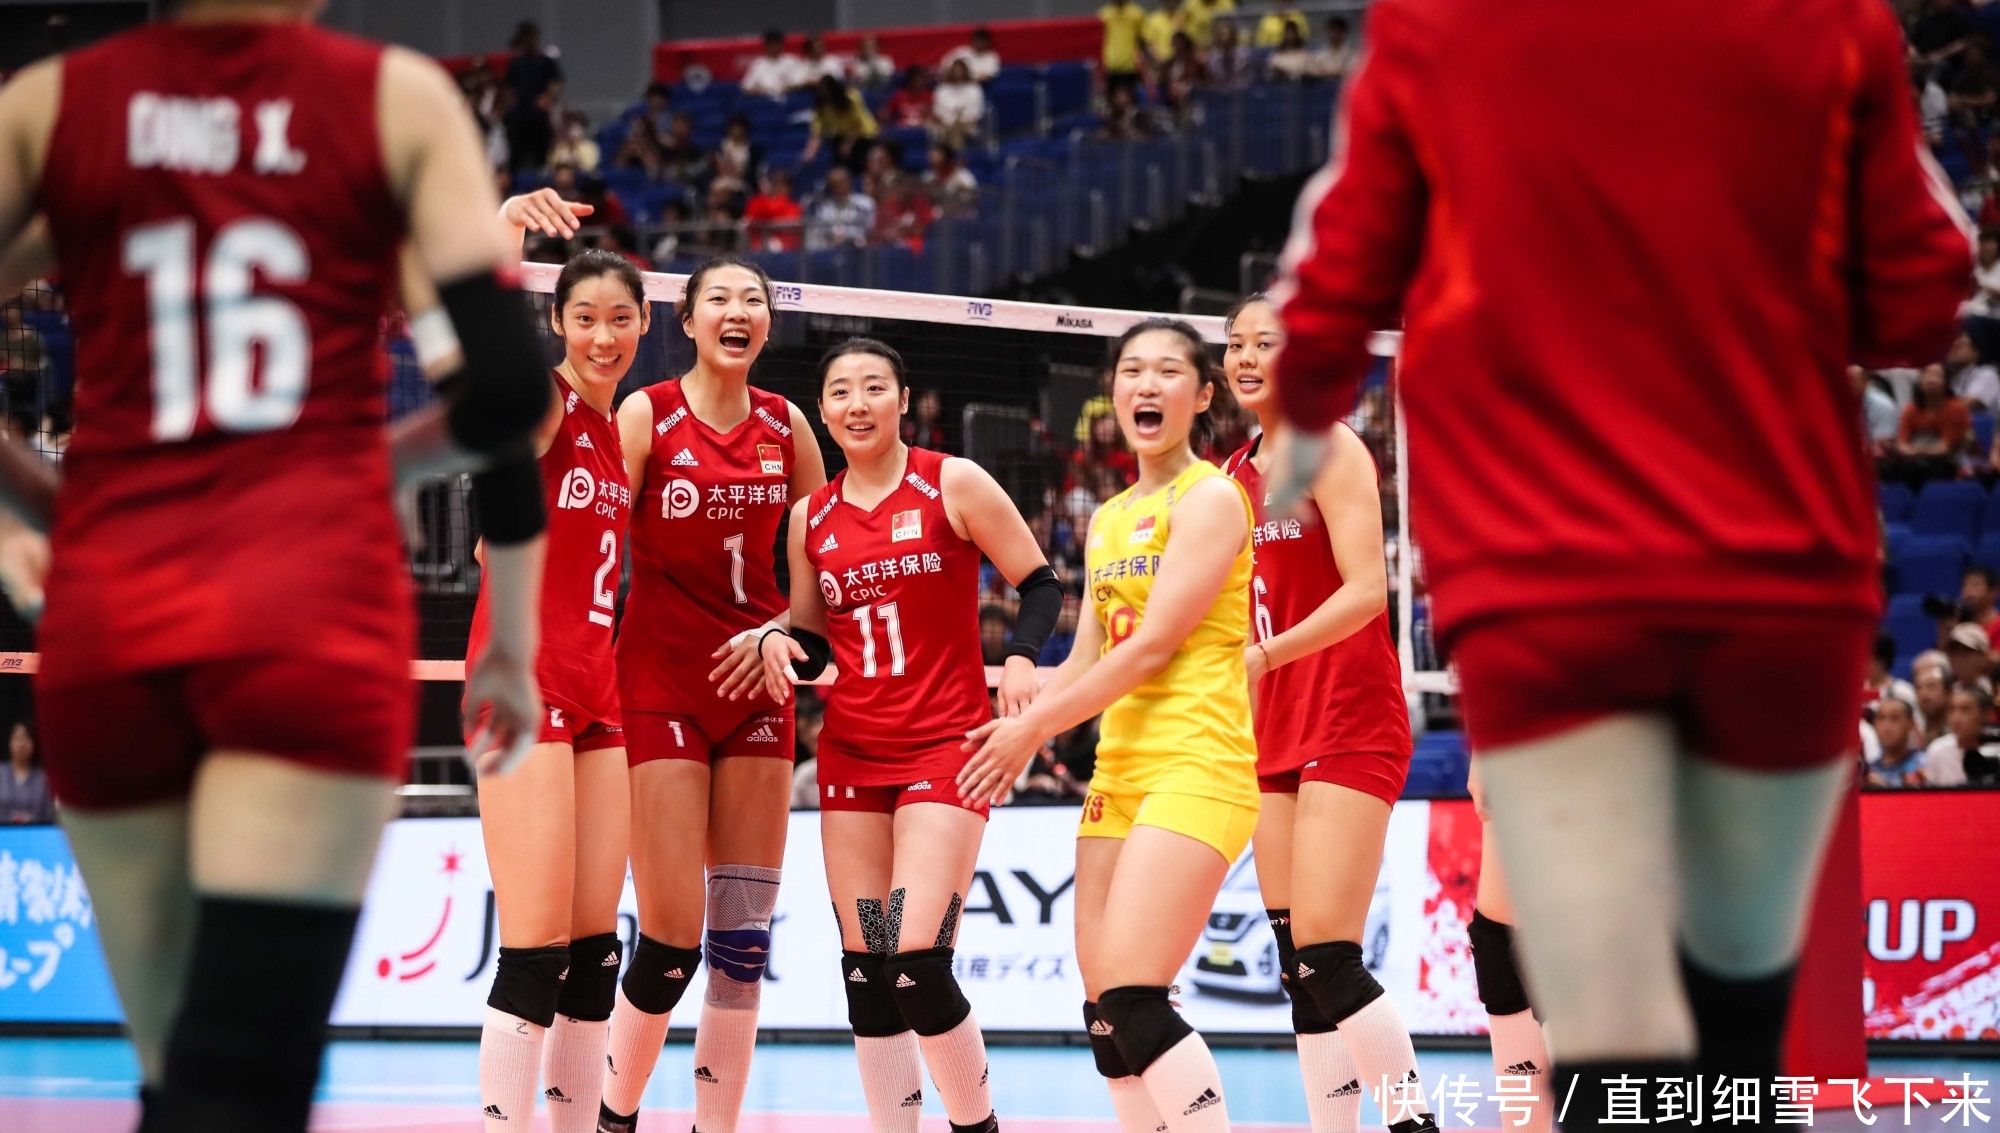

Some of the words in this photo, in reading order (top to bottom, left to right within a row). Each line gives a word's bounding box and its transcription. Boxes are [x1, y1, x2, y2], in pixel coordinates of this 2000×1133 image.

[121, 216, 313, 442] 16
[670, 456, 699, 467] adidas
[764, 462, 782, 472] CHN
[595, 501, 618, 521] CPIC
[706, 507, 745, 520] CPIC
[895, 528, 918, 539] CHN
[593, 529, 617, 610] 2
[723, 532, 748, 604] 1
[843, 552, 942, 588] 太平洋保险
[850, 584, 887, 601] CPIC
[852, 601, 906, 678] 11
[667, 720, 685, 748] 1
[746, 734, 779, 743] adidas
